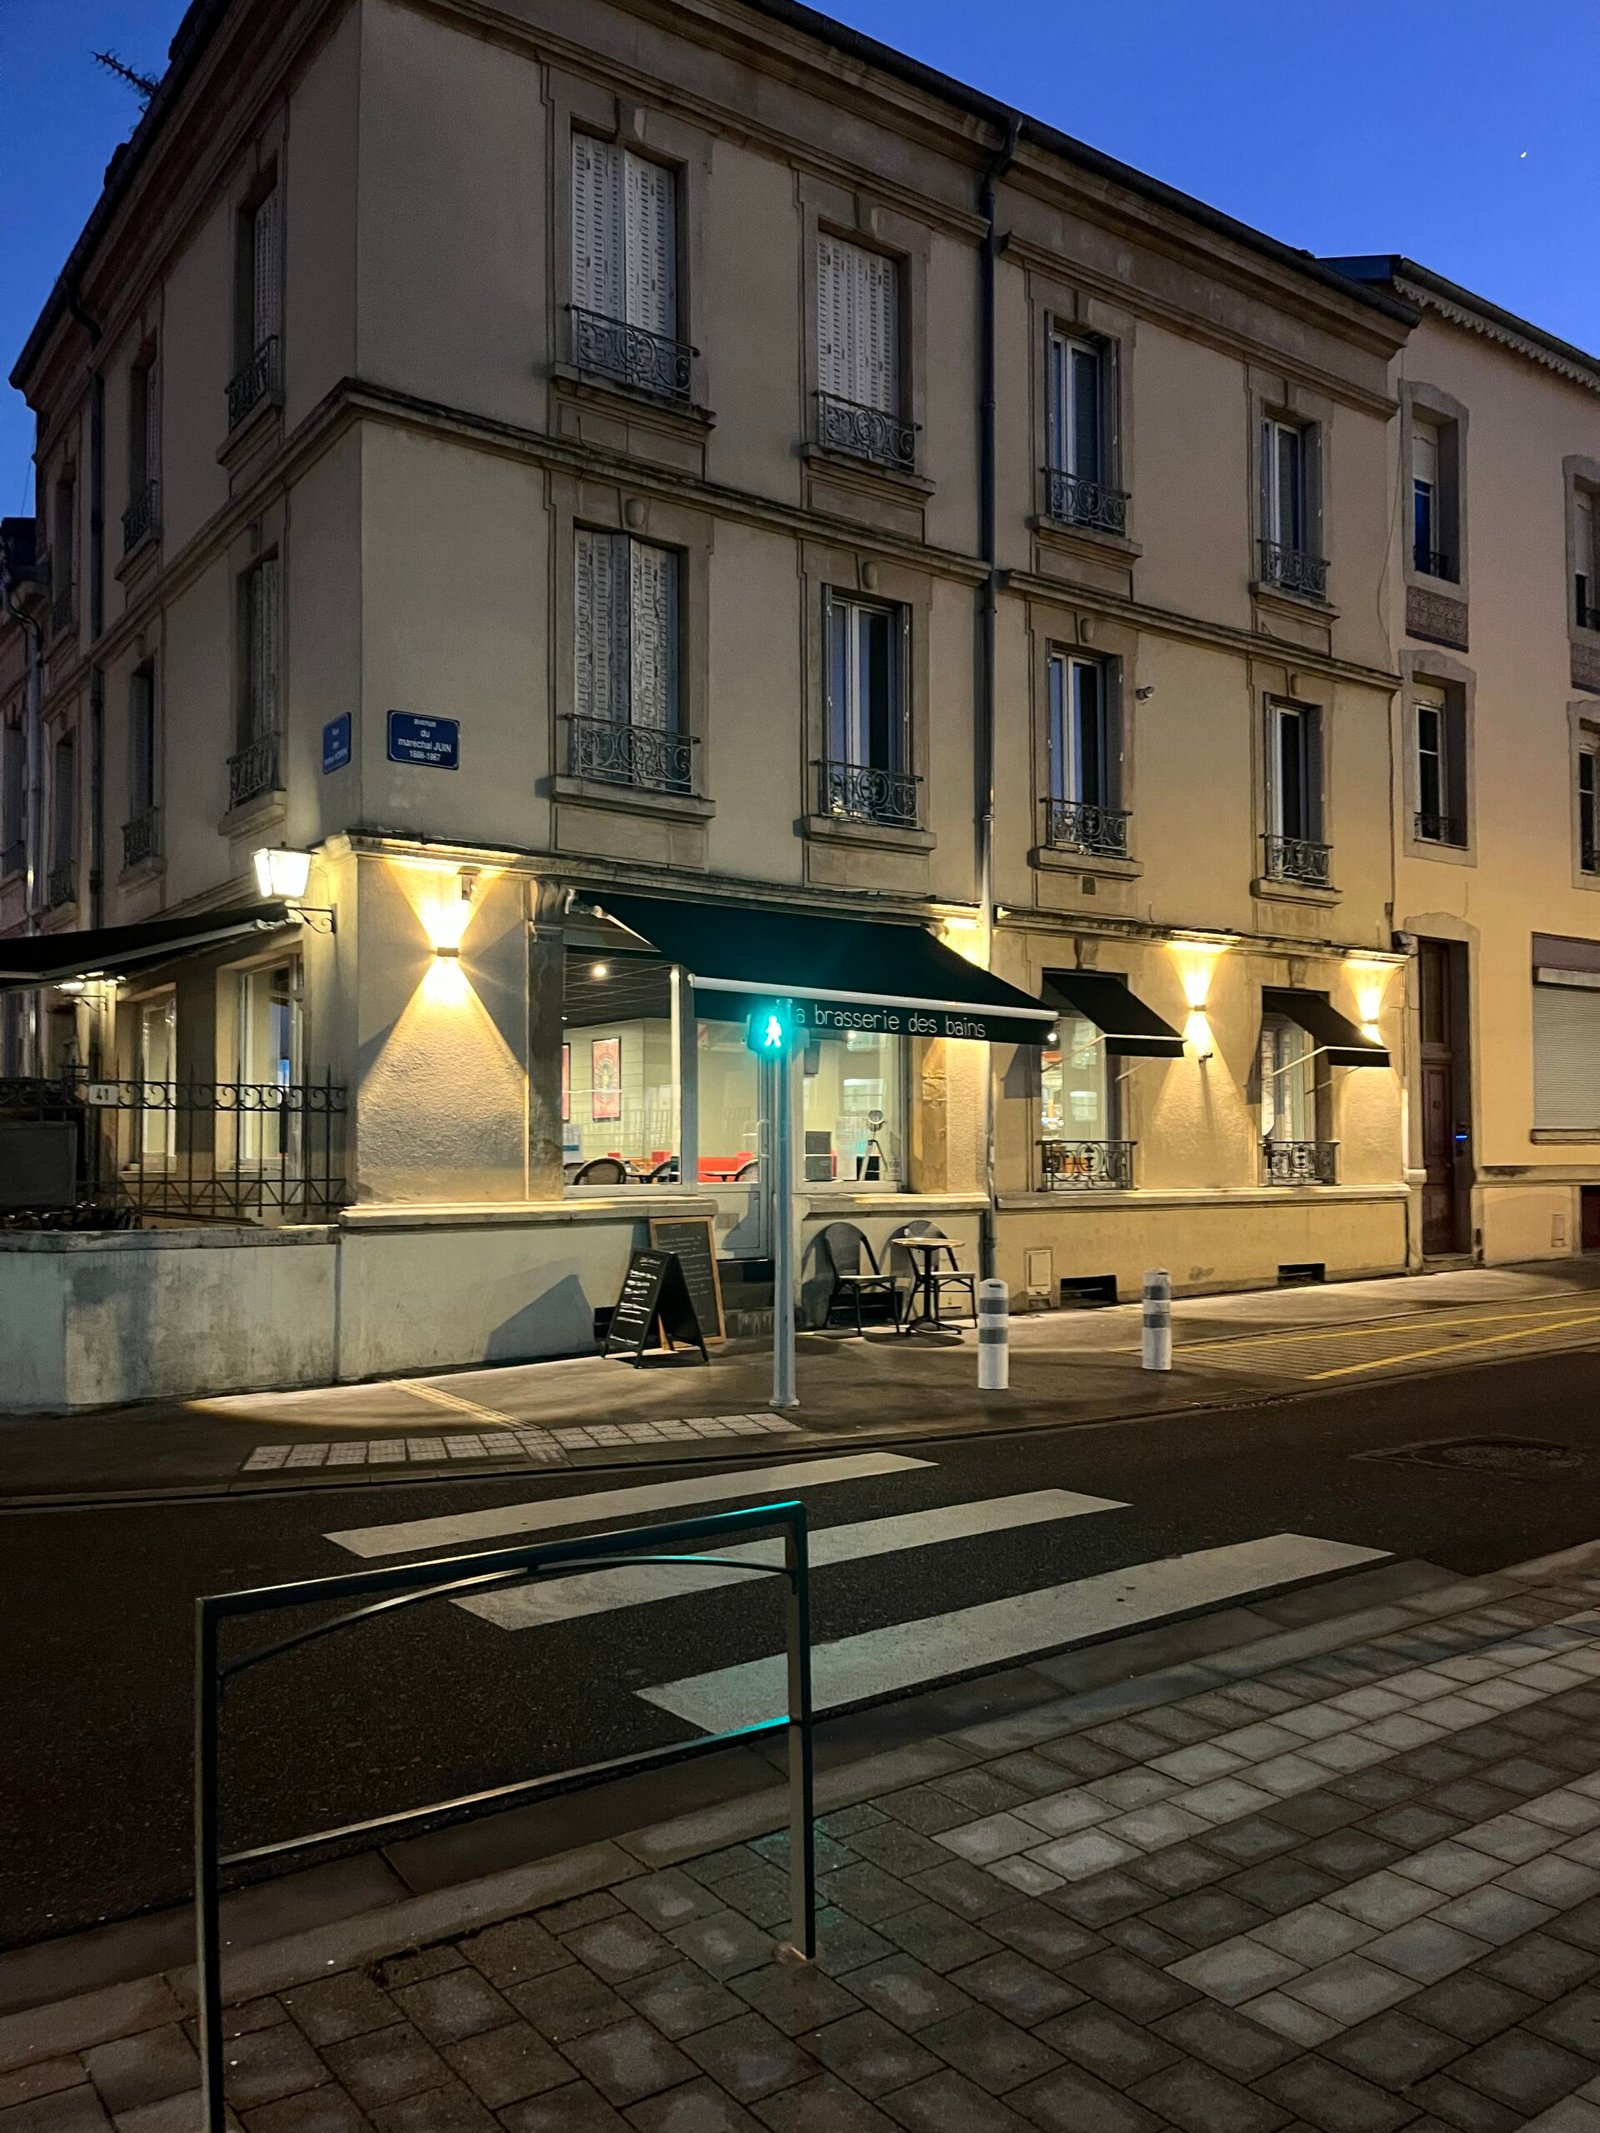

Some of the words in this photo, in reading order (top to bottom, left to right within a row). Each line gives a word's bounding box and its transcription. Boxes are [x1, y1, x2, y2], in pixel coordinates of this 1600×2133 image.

[420, 728, 431, 738] du
[433, 742, 452, 753] JUIN
[814, 1003, 900, 1031] brasserie
[908, 1012, 938, 1034] des
[945, 1014, 986, 1038] bains
